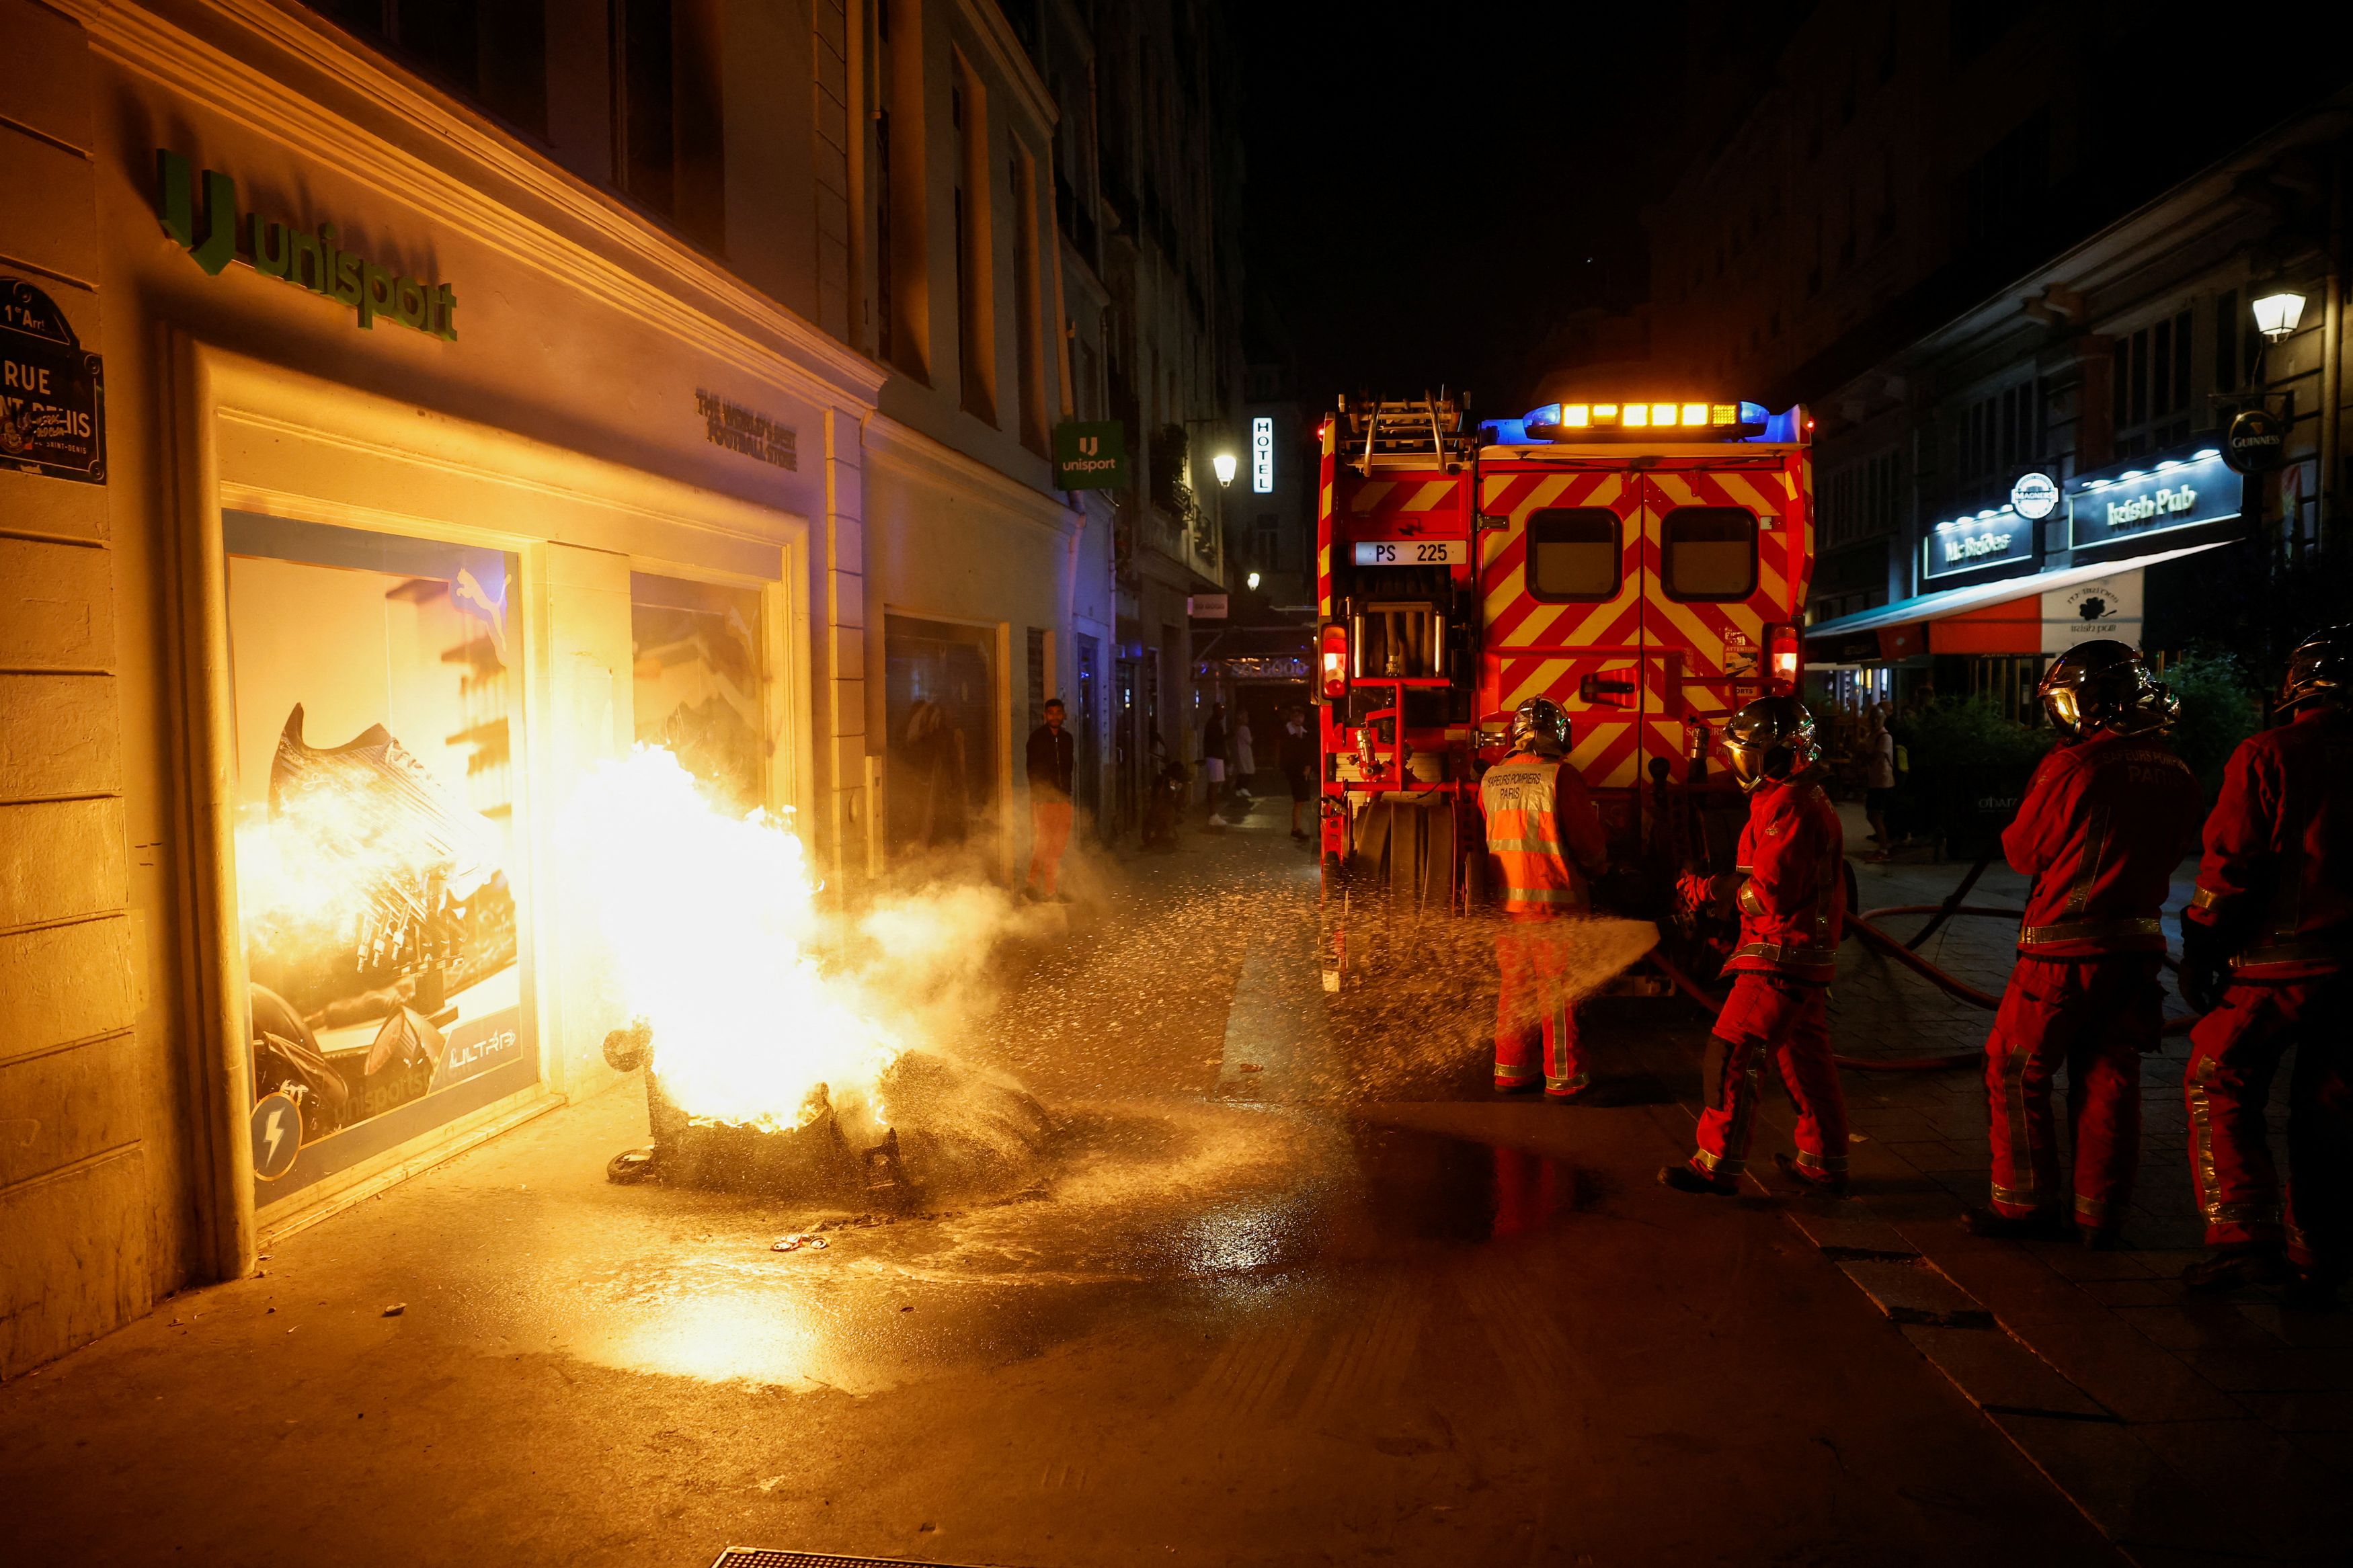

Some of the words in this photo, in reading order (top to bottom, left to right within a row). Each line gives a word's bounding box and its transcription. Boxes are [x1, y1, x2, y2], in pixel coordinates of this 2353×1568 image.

[246, 212, 458, 342] unisport
[4, 359, 52, 395] RUE
[2232, 434, 2280, 448] GUINNESS
[1062, 458, 1116, 473] unisport
[1257, 422, 1269, 489] HOTEL
[2106, 494, 2155, 526] Irish
[2155, 484, 2198, 515] Pub
[1376, 544, 1396, 562] PS
[1417, 544, 1447, 561] 225
[1487, 774, 1511, 788] SAPEURS
[1510, 773, 1542, 785] POMPIERS
[2127, 764, 2183, 787] PARIS
[1500, 787, 1520, 800] PARIS
[449, 1028, 516, 1069] ULTRA
